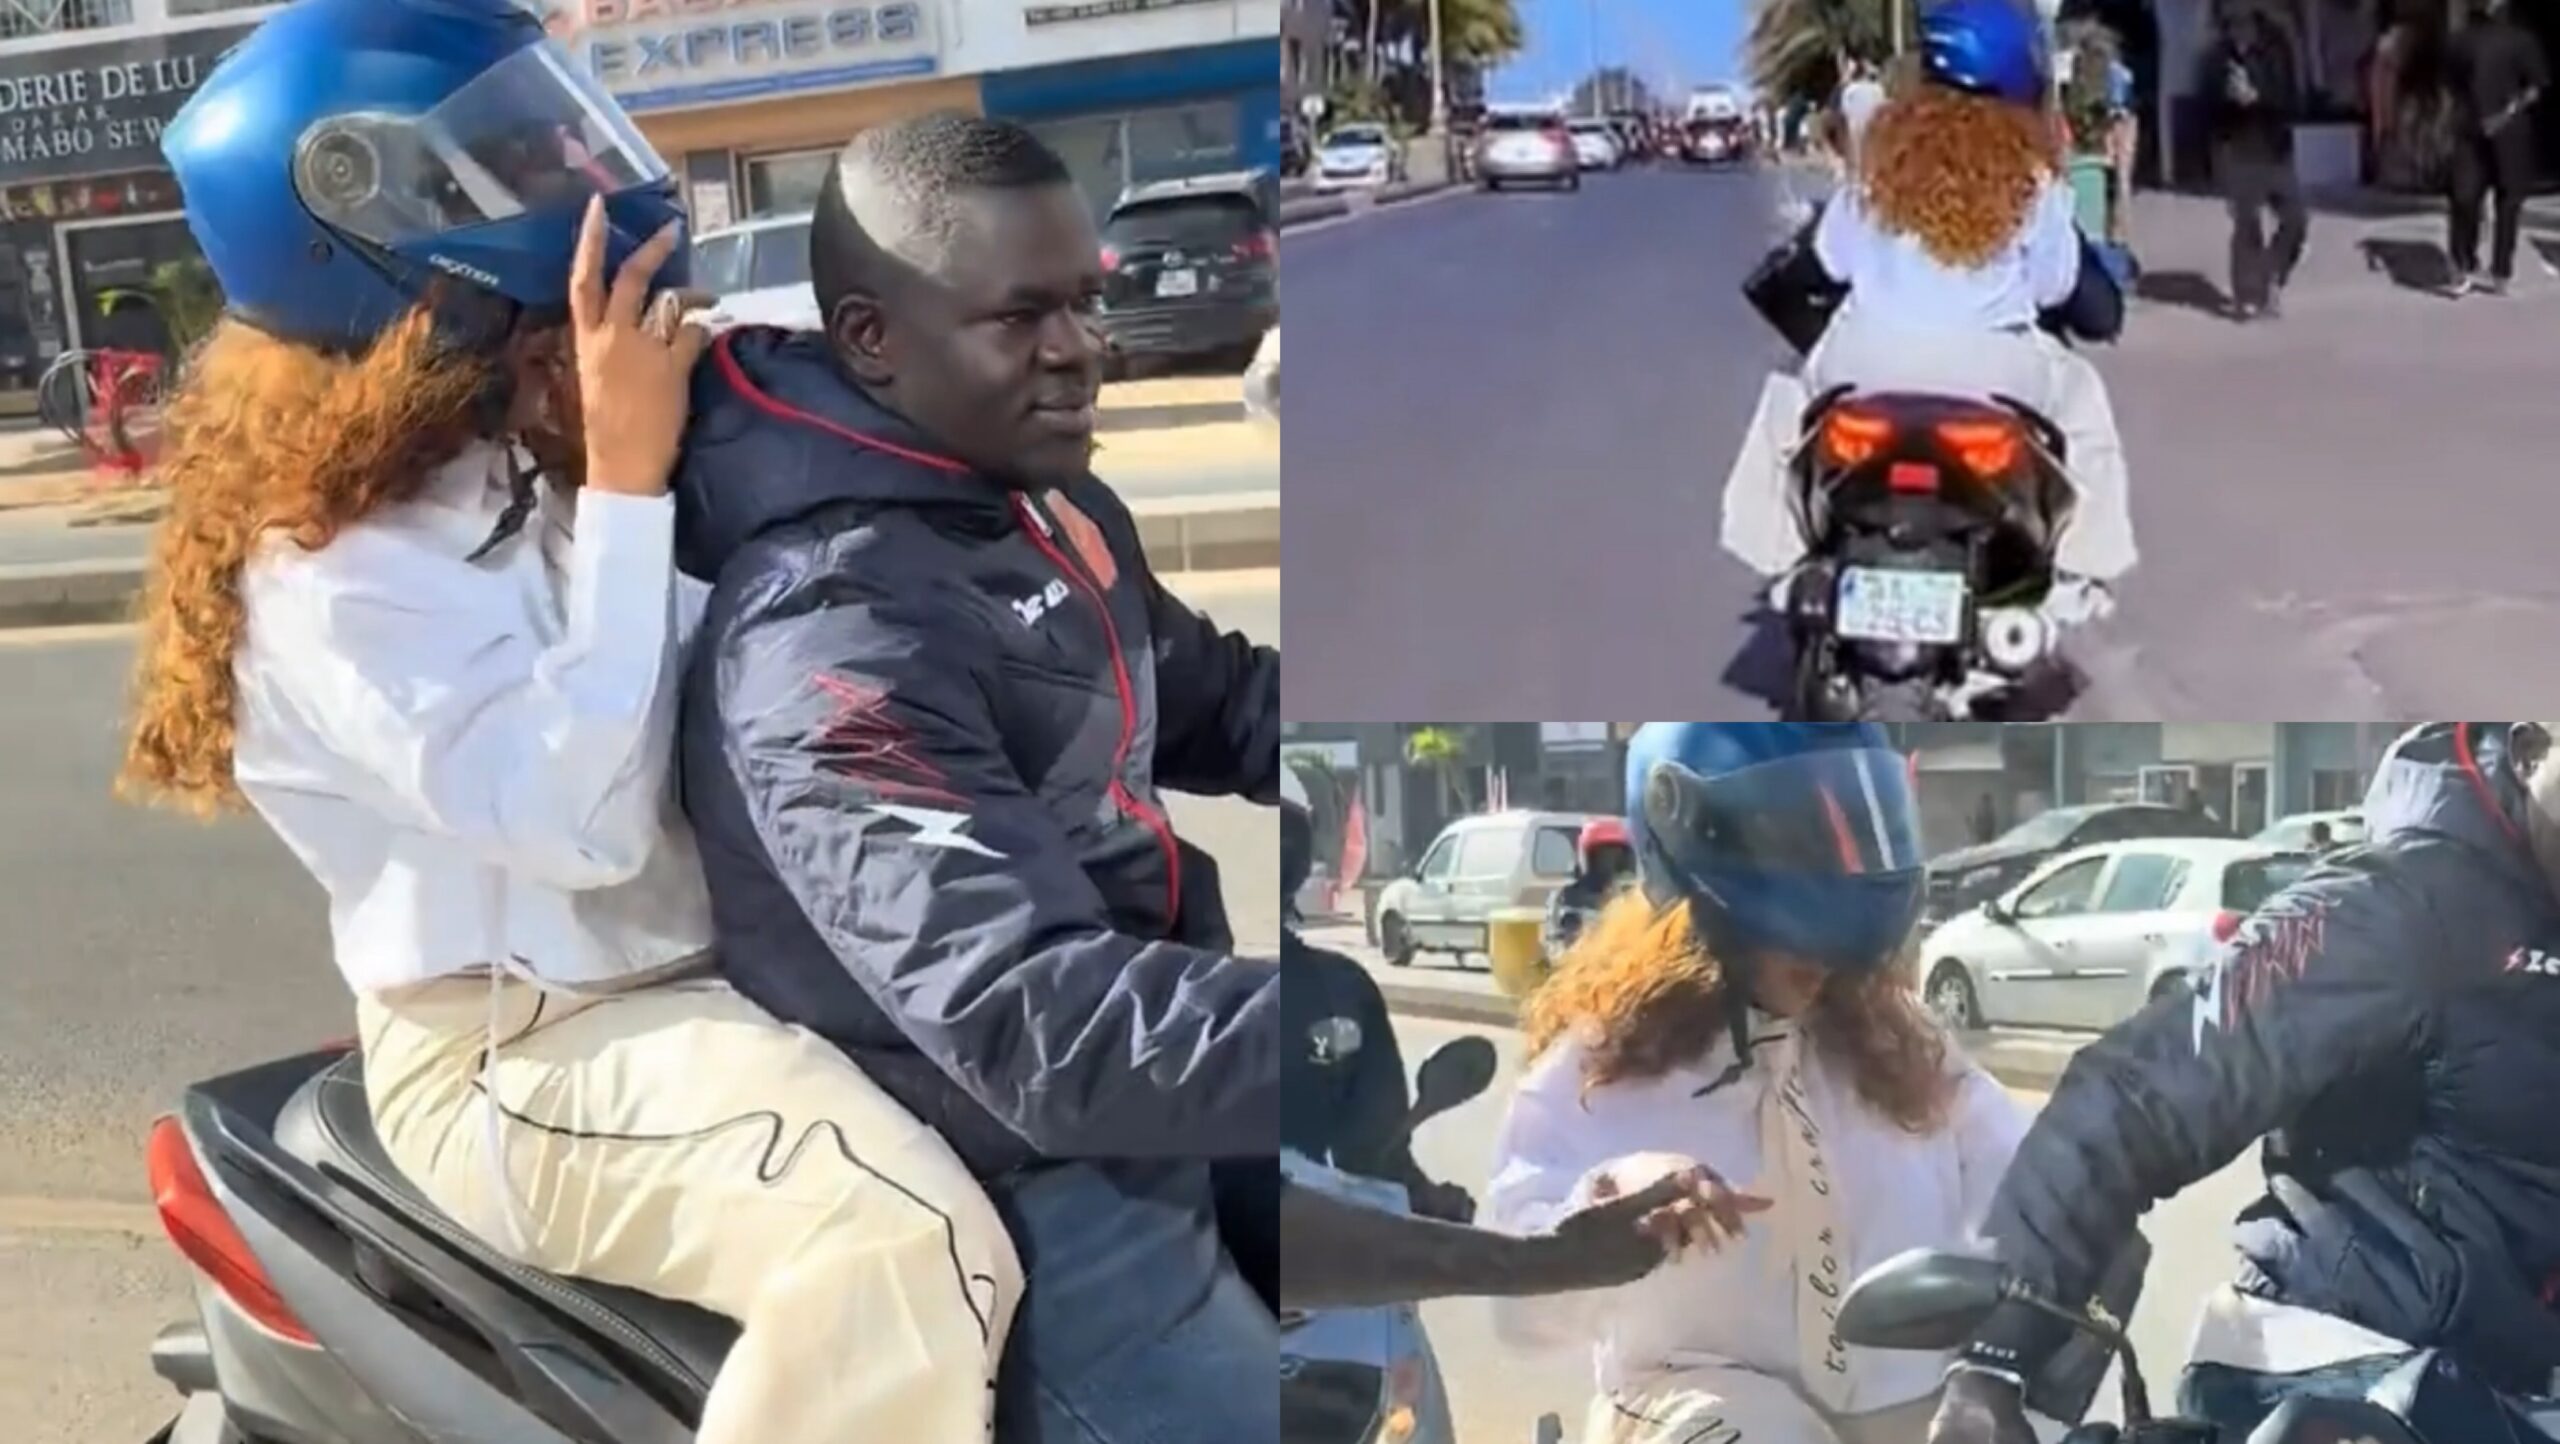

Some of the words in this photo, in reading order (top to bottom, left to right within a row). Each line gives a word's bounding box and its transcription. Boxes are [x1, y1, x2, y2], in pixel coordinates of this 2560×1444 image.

[590, 2, 920, 79] EXPRESS
[100, 62, 146, 99] DE
[11, 104, 110, 133] DAKAR
[2, 127, 94, 163] MABO
[1808, 1226, 1847, 1375] tailor
